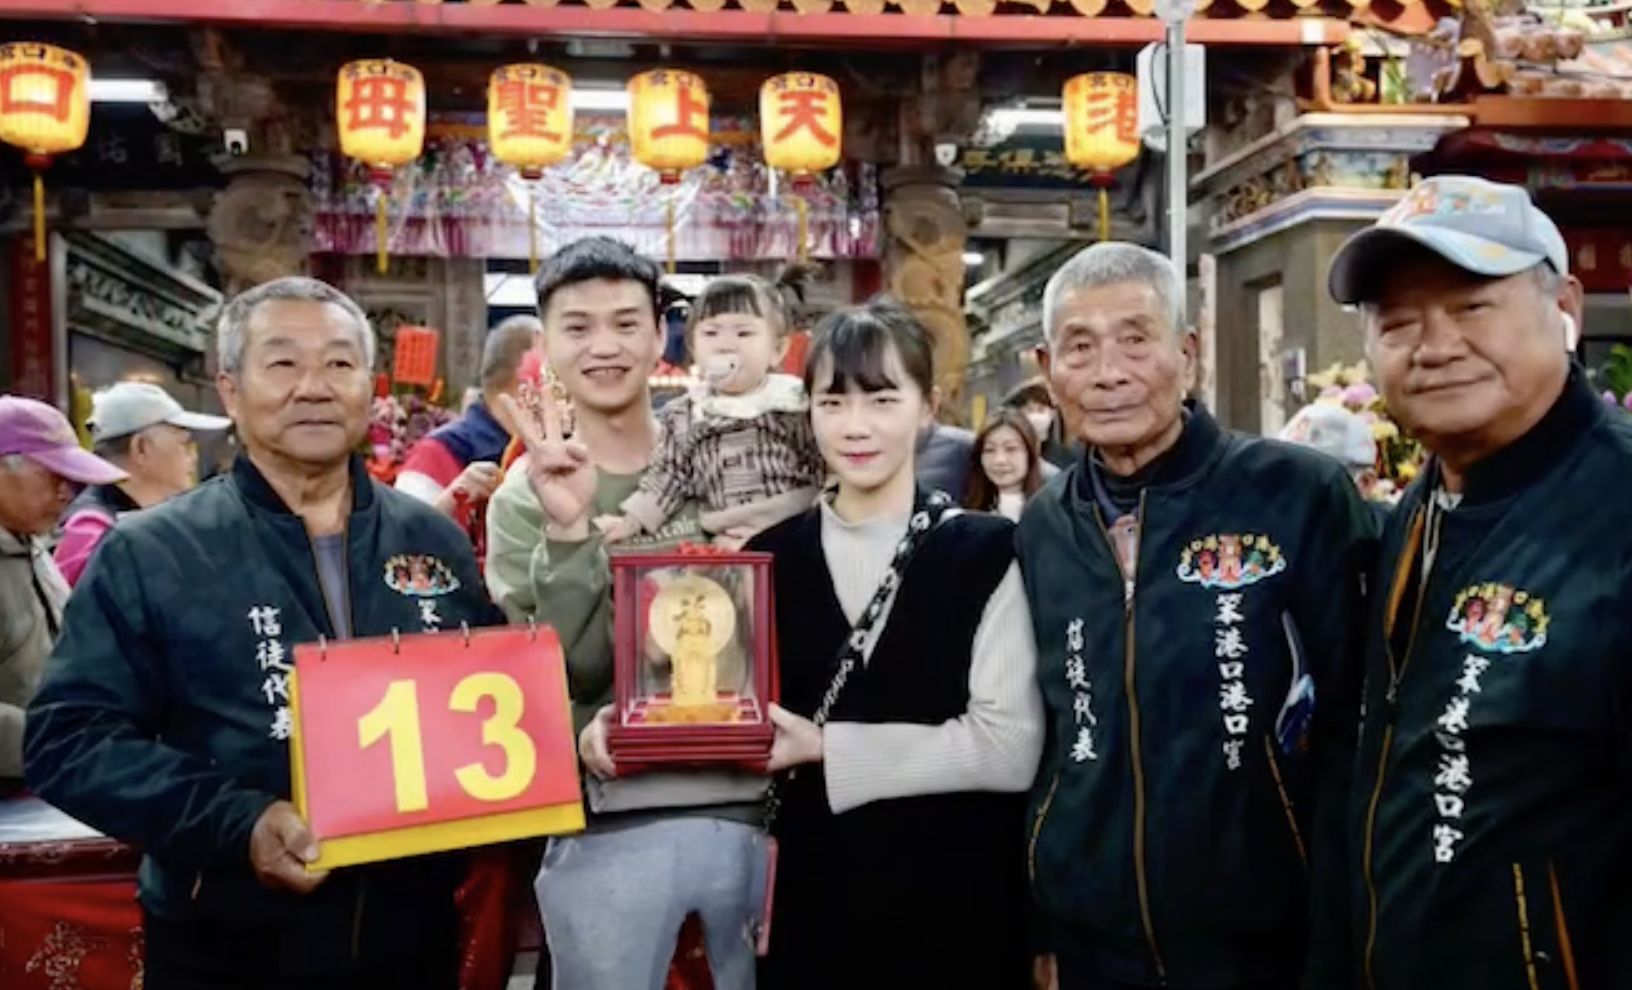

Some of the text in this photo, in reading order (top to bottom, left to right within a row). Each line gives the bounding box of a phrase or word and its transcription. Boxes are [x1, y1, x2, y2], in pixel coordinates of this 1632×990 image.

[0, 63, 76, 123] 口
[346, 75, 416, 140] 母
[497, 79, 563, 142] 聖
[650, 84, 711, 143] 上
[773, 91, 838, 149] 天
[1214, 592, 1255, 771] 笨港口港口宮
[357, 671, 538, 814] 13
